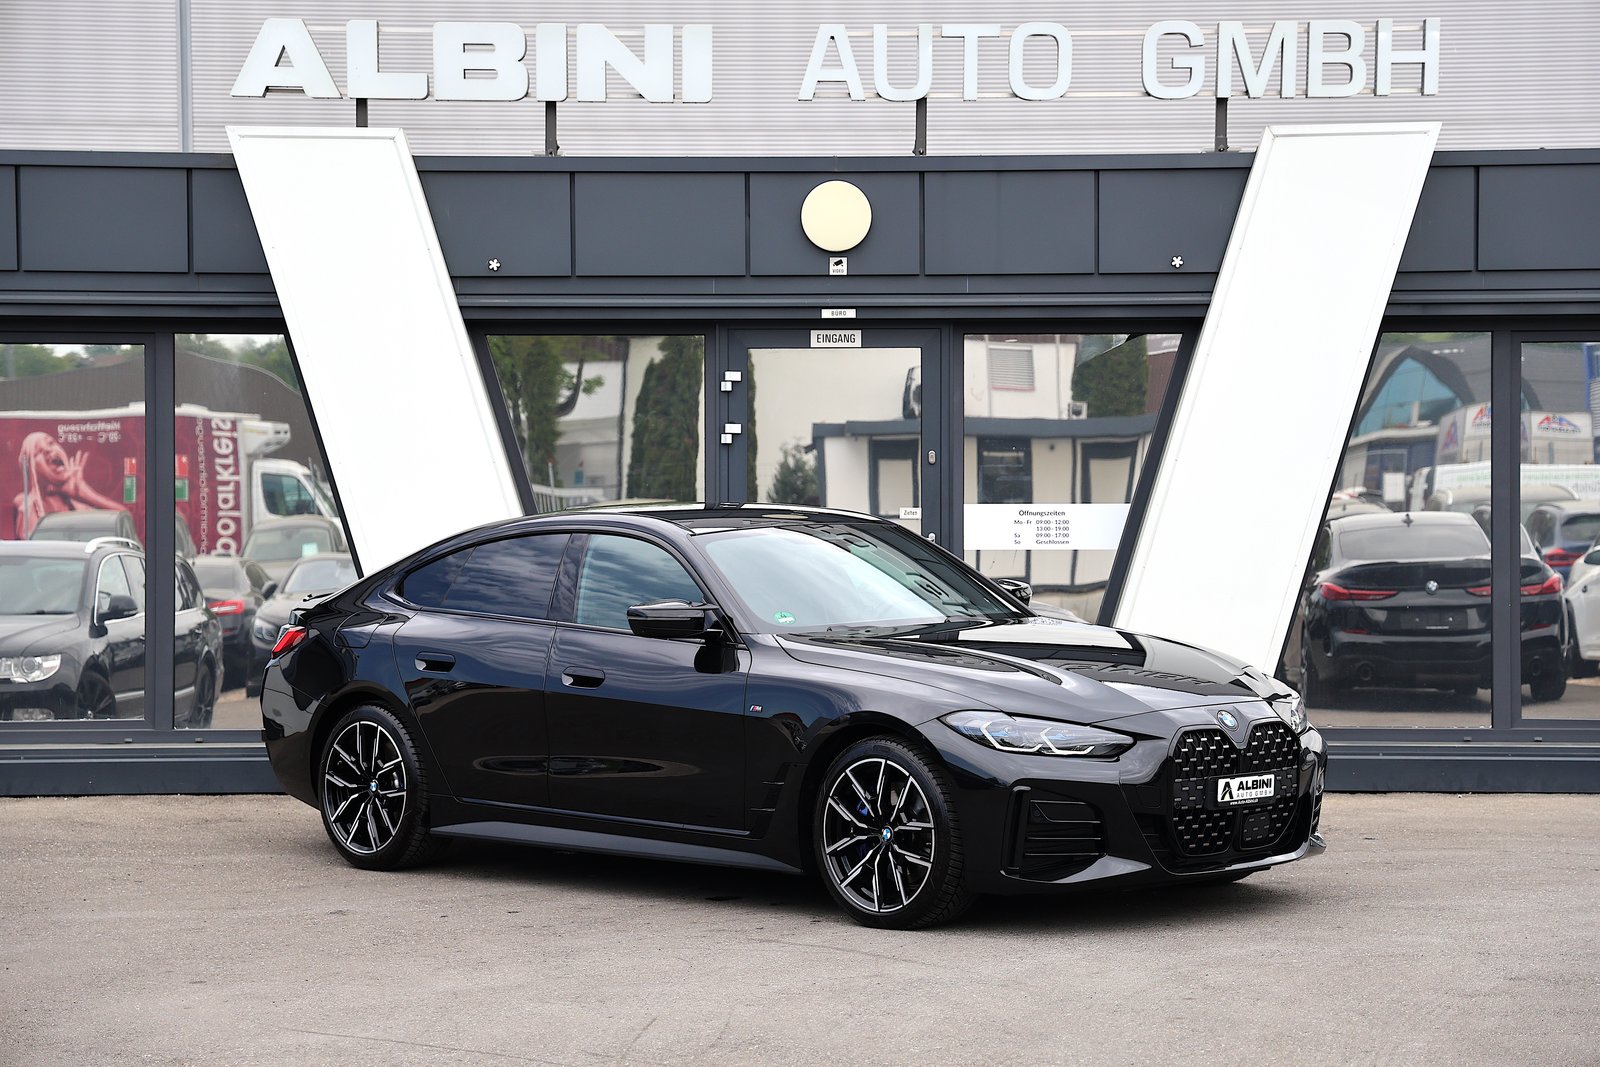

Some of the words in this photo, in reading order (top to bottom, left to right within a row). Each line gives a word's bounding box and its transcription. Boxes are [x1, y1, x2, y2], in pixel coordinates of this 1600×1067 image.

[230, 18, 712, 103] ALBINI
[798, 21, 1073, 101] AUTO
[1141, 18, 1441, 99] GMBH
[816, 333, 856, 344] EINGANG
[1237, 777, 1272, 791] ALBINI
